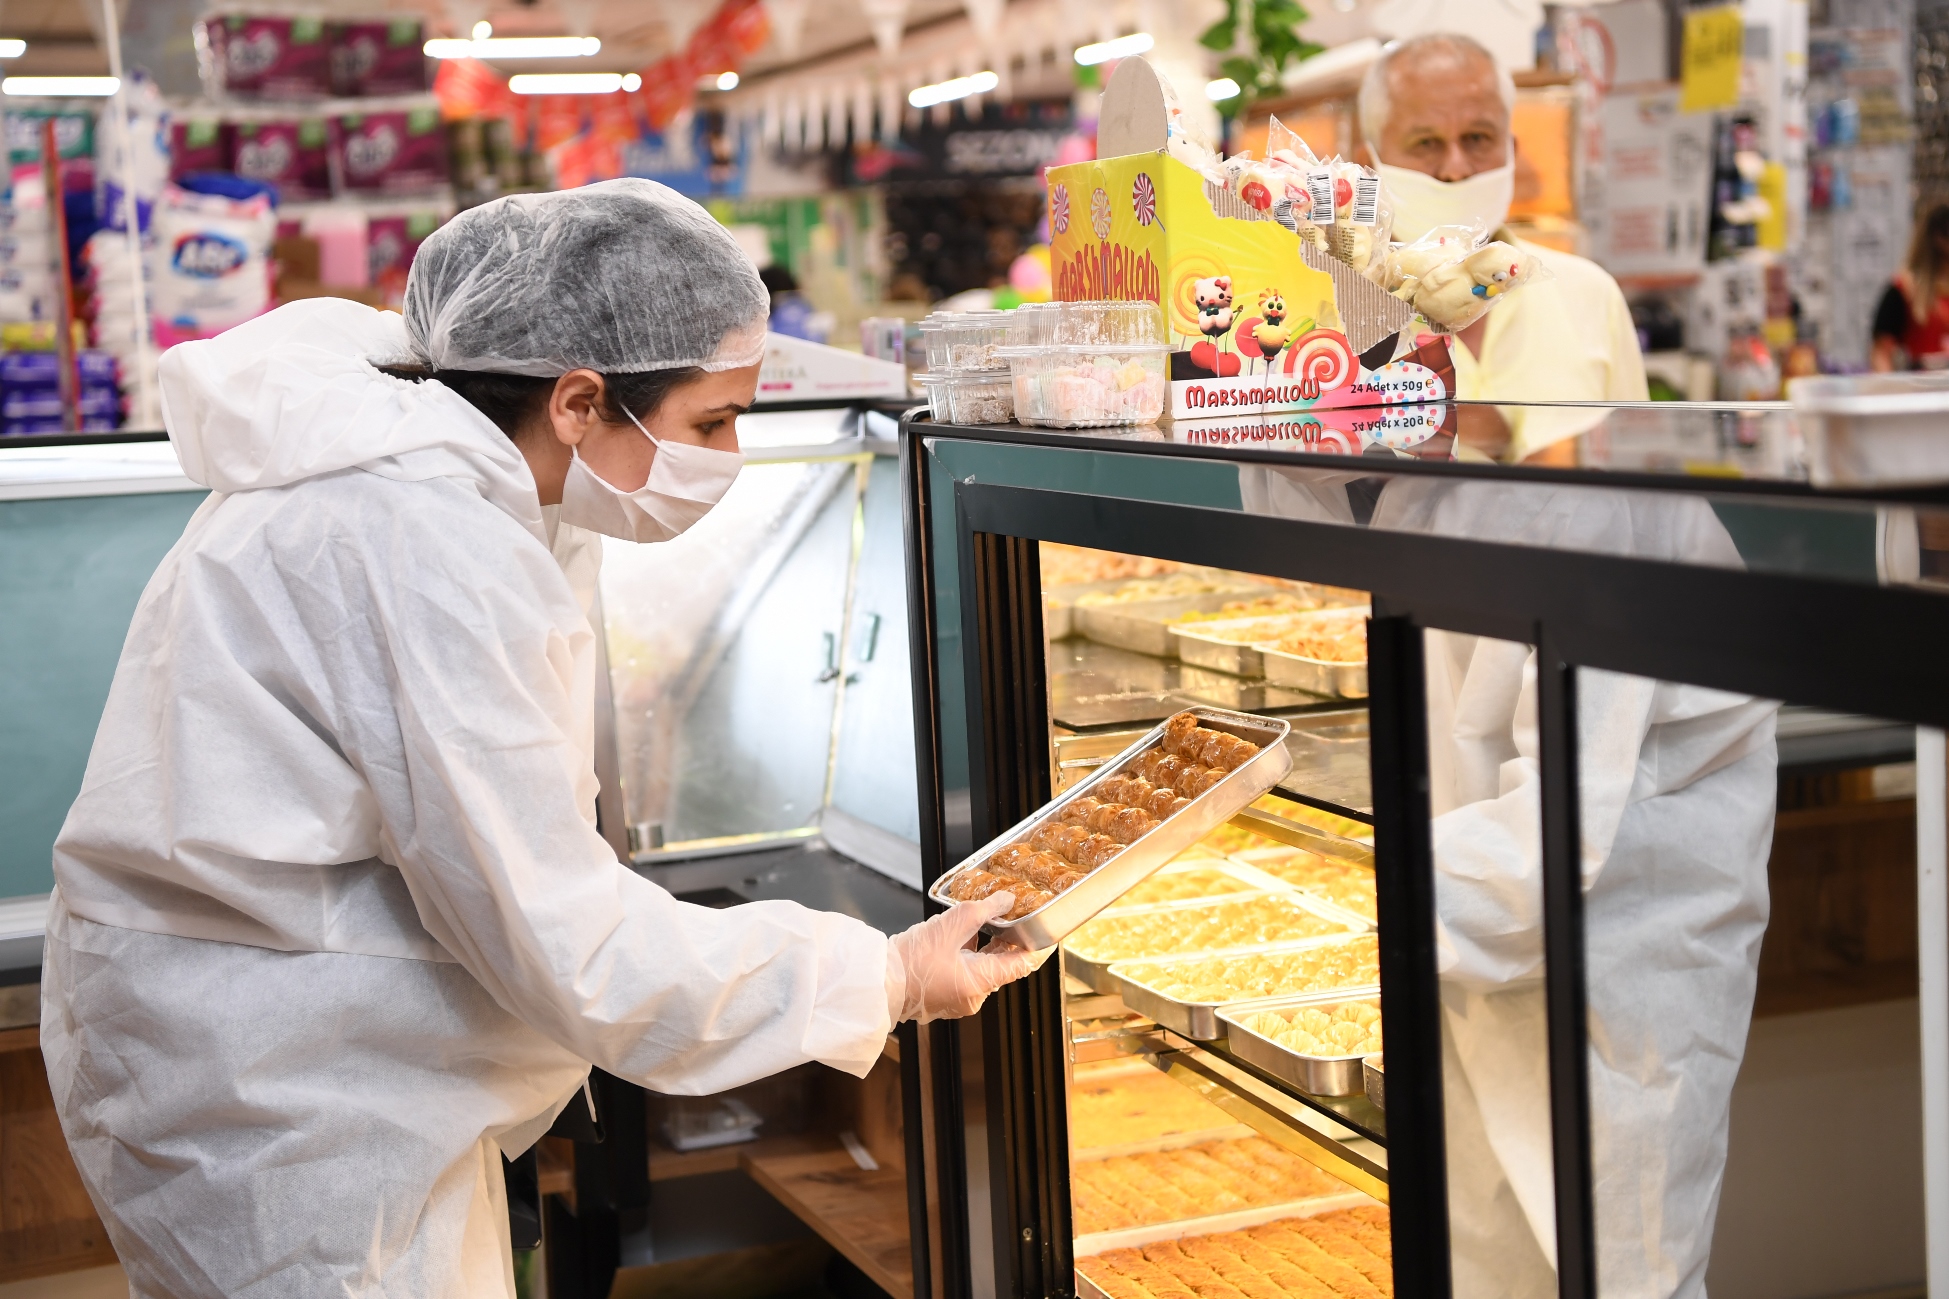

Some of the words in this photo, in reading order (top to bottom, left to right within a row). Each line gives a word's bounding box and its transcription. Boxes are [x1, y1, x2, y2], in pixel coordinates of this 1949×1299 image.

[1350, 384, 1363, 394] 24
[1365, 382, 1391, 393] Adet
[1392, 383, 1399, 391] x
